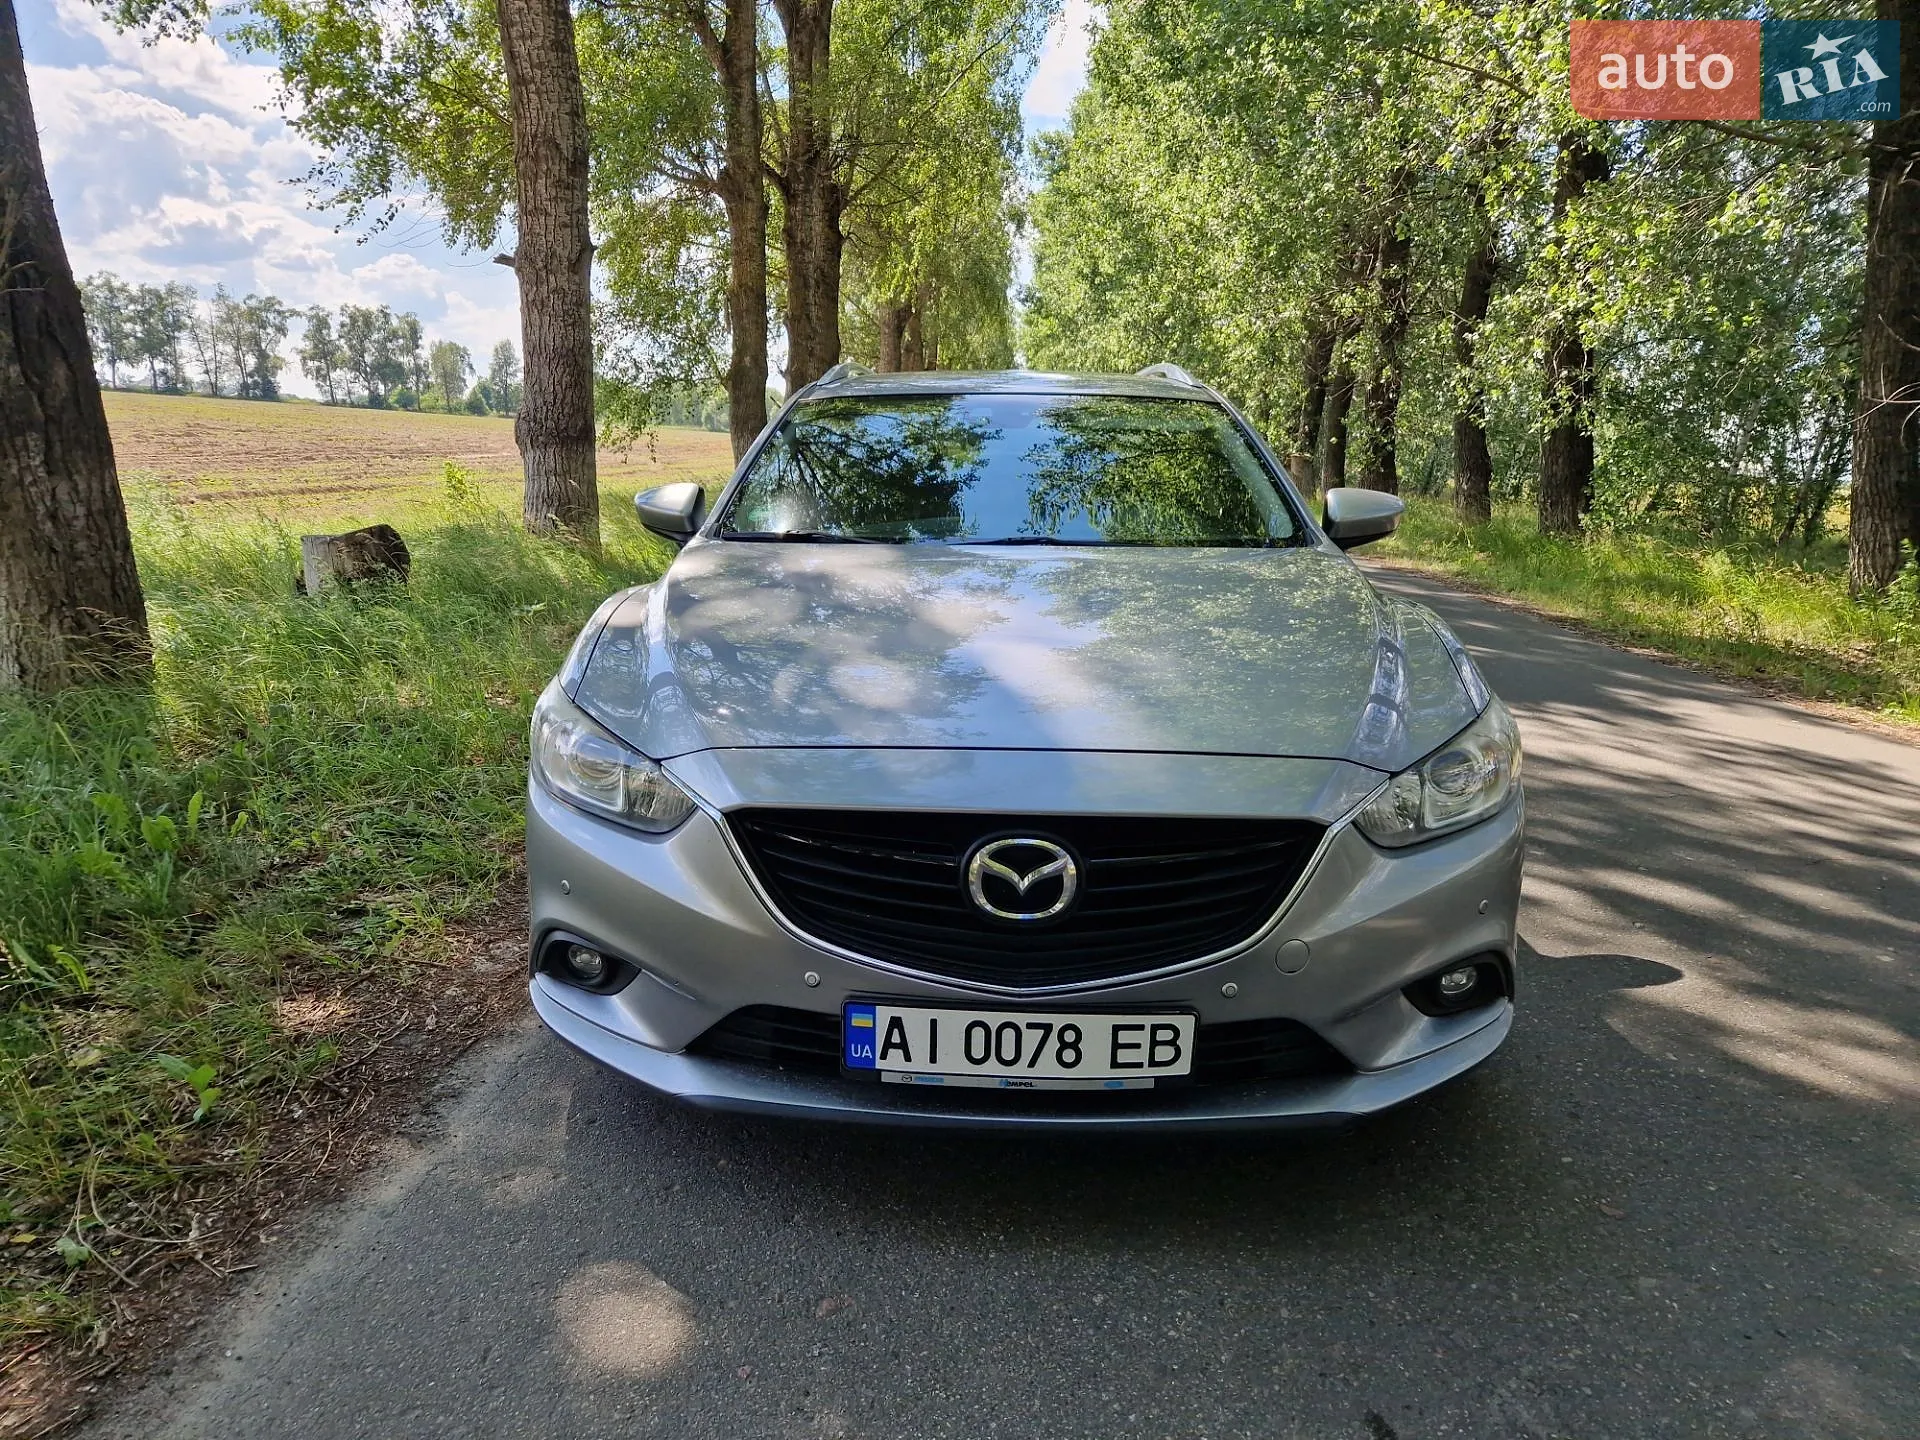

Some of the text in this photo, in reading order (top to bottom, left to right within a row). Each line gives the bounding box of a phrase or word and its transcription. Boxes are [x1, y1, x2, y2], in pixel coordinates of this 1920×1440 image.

[851, 1043, 872, 1059] UA
[879, 1015, 1182, 1070] AI 0078 EB
